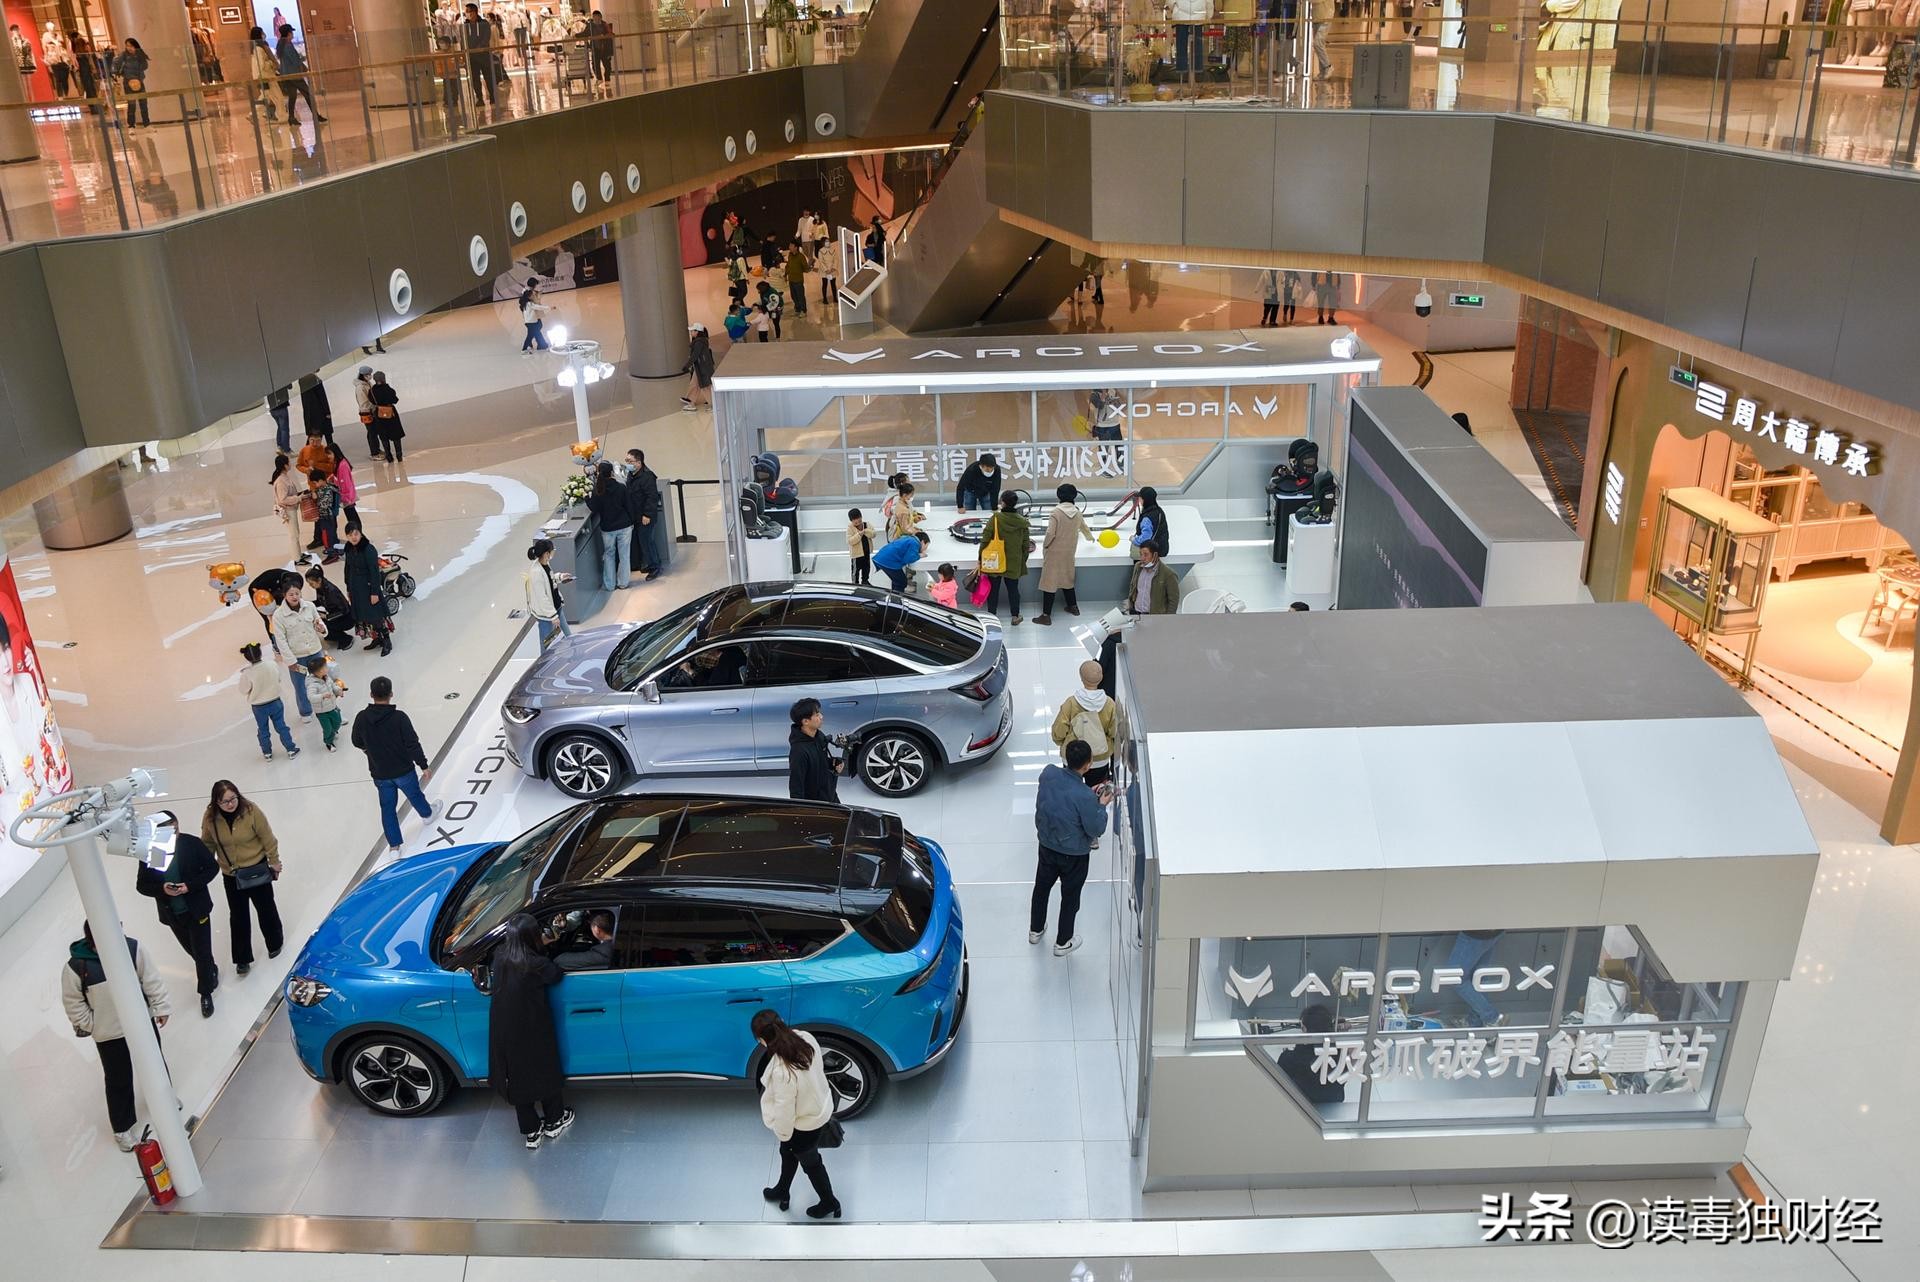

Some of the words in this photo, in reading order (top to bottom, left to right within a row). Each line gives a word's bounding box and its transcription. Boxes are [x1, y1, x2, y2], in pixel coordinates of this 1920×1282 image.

[910, 341, 1266, 360] ARCFOX
[1732, 398, 1871, 477] 周大福傳承
[426, 727, 506, 847] RCFOX
[1290, 964, 1555, 998] ARCFOX
[1310, 1026, 1717, 1085] 极狐破界能量站
